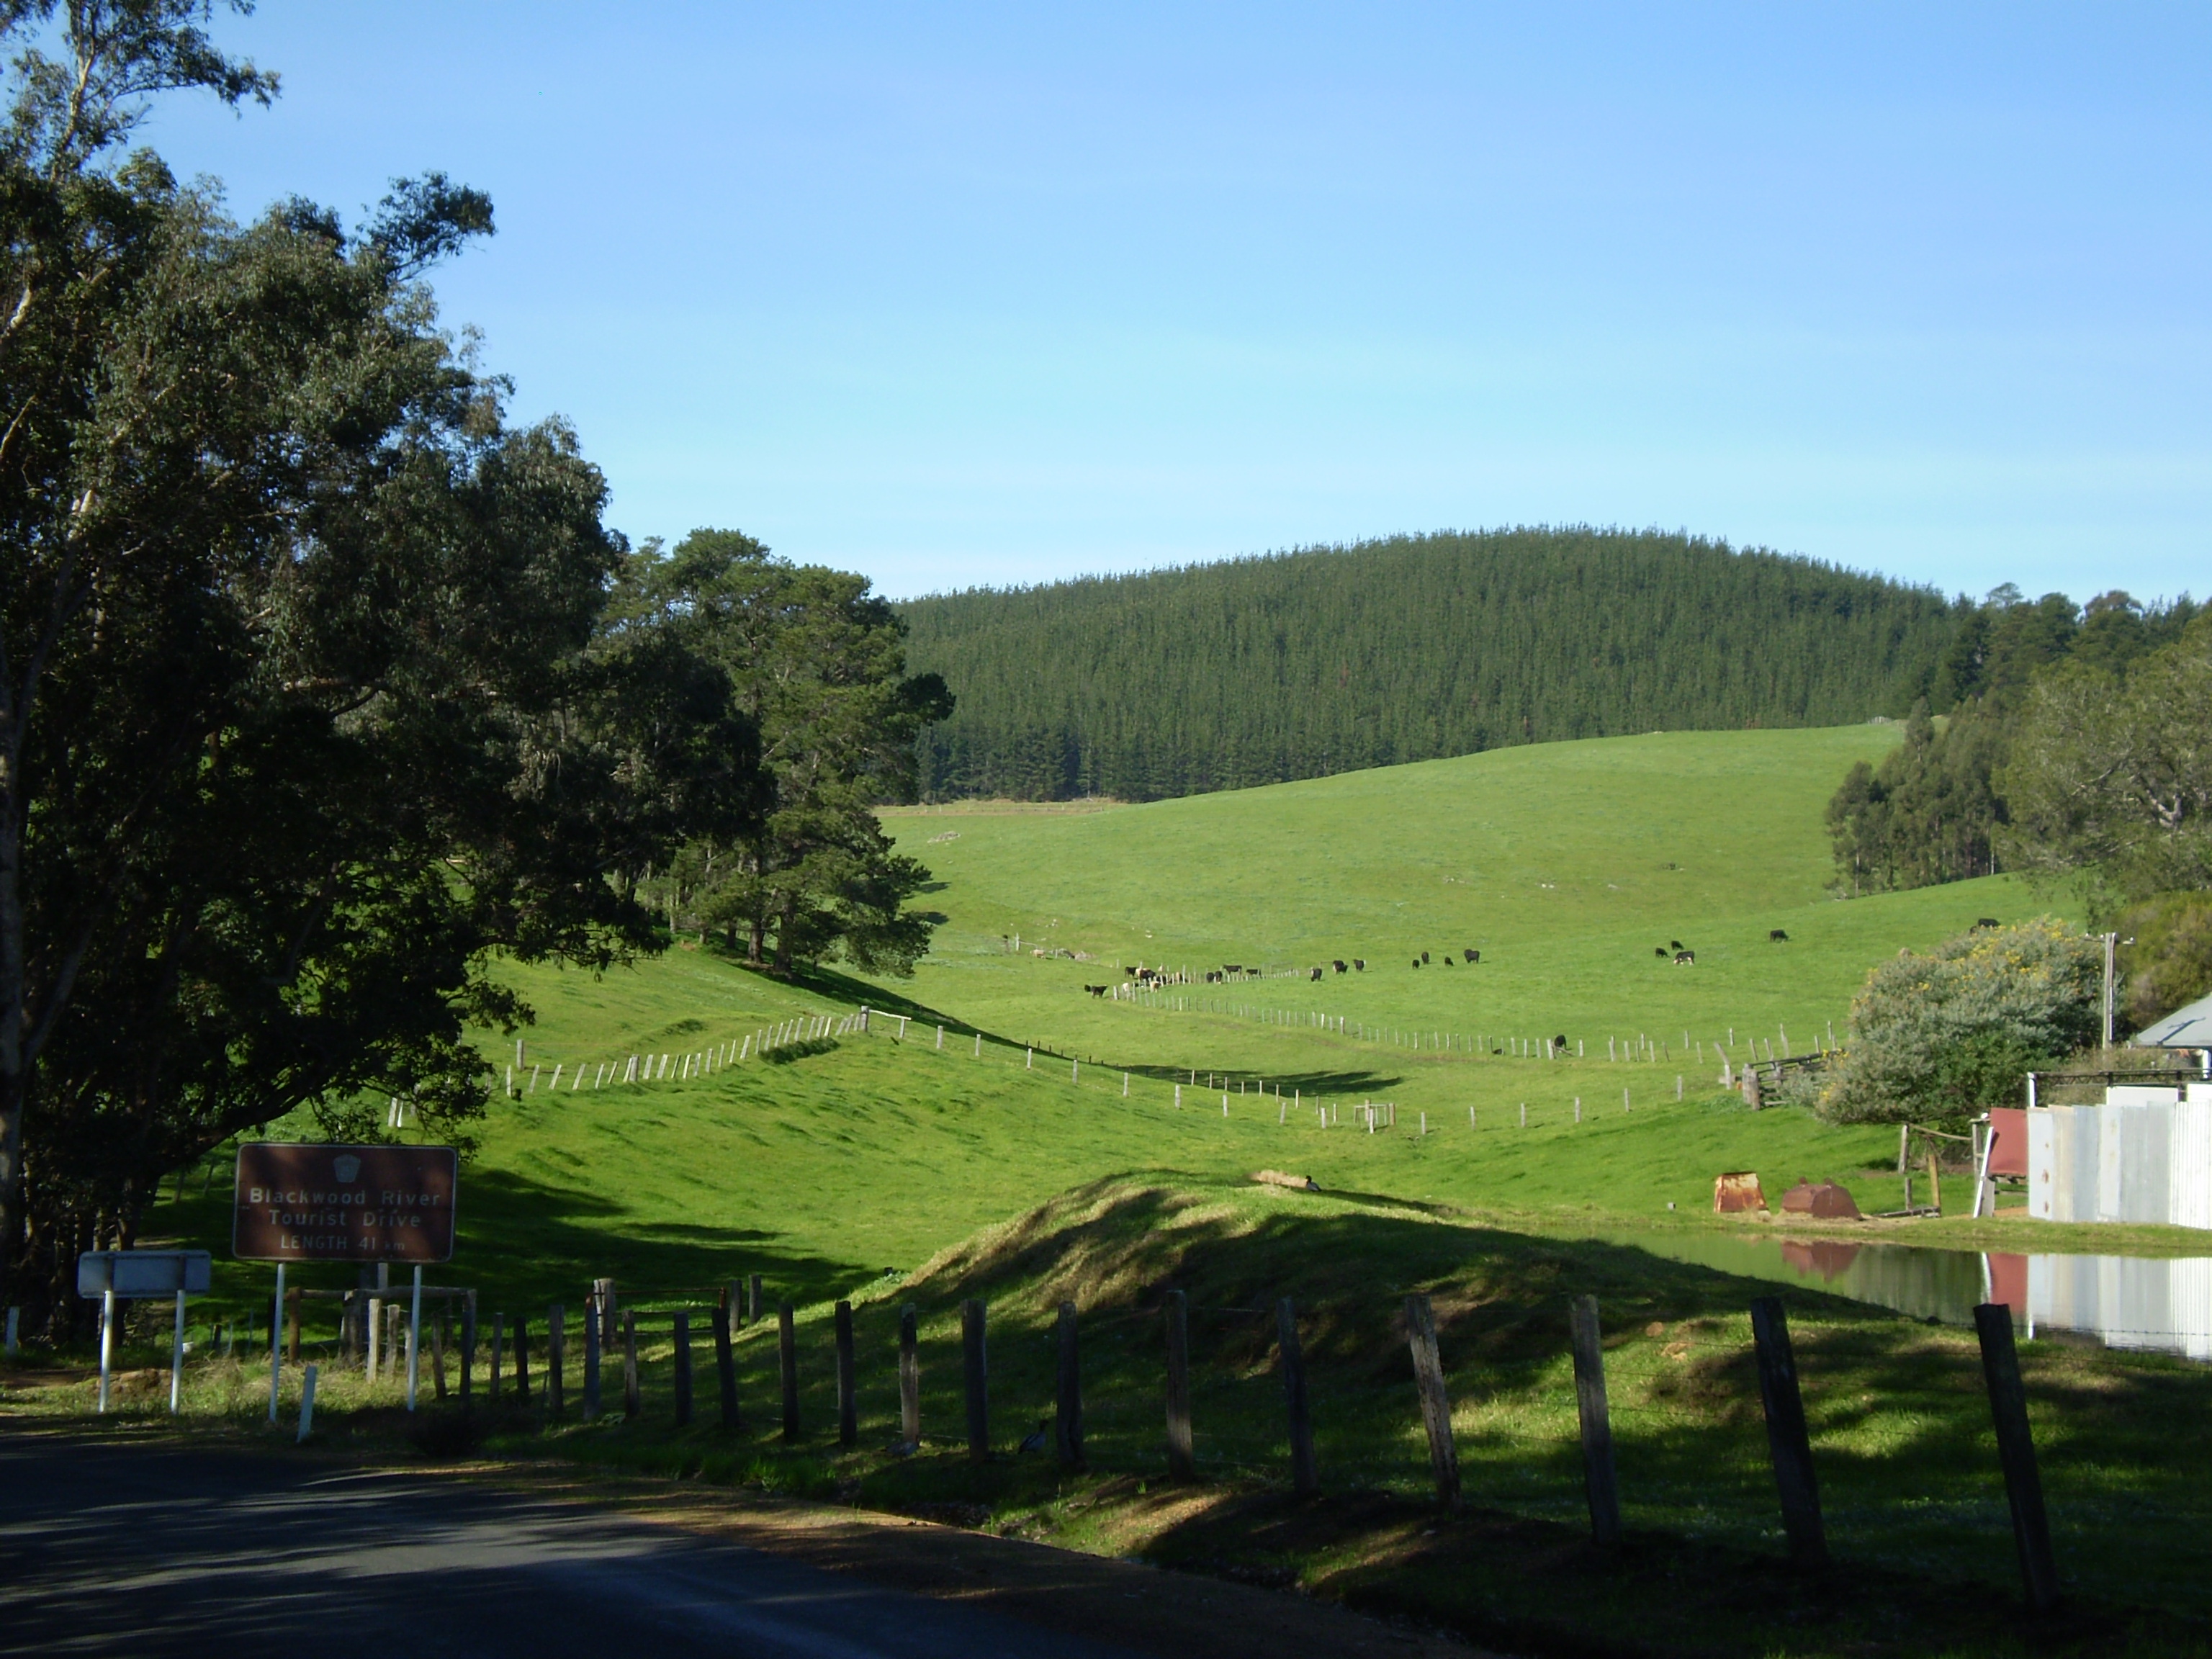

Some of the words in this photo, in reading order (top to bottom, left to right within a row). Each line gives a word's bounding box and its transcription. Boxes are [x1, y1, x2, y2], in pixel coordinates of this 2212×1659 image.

[249, 1187, 366, 1205] Blackwood
[382, 1190, 440, 1206] River
[269, 1209, 346, 1226] Tourist
[363, 1210, 421, 1227] Drive
[281, 1235, 347, 1250] LENGTH
[358, 1236, 376, 1250] 41
[385, 1241, 405, 1251] km
